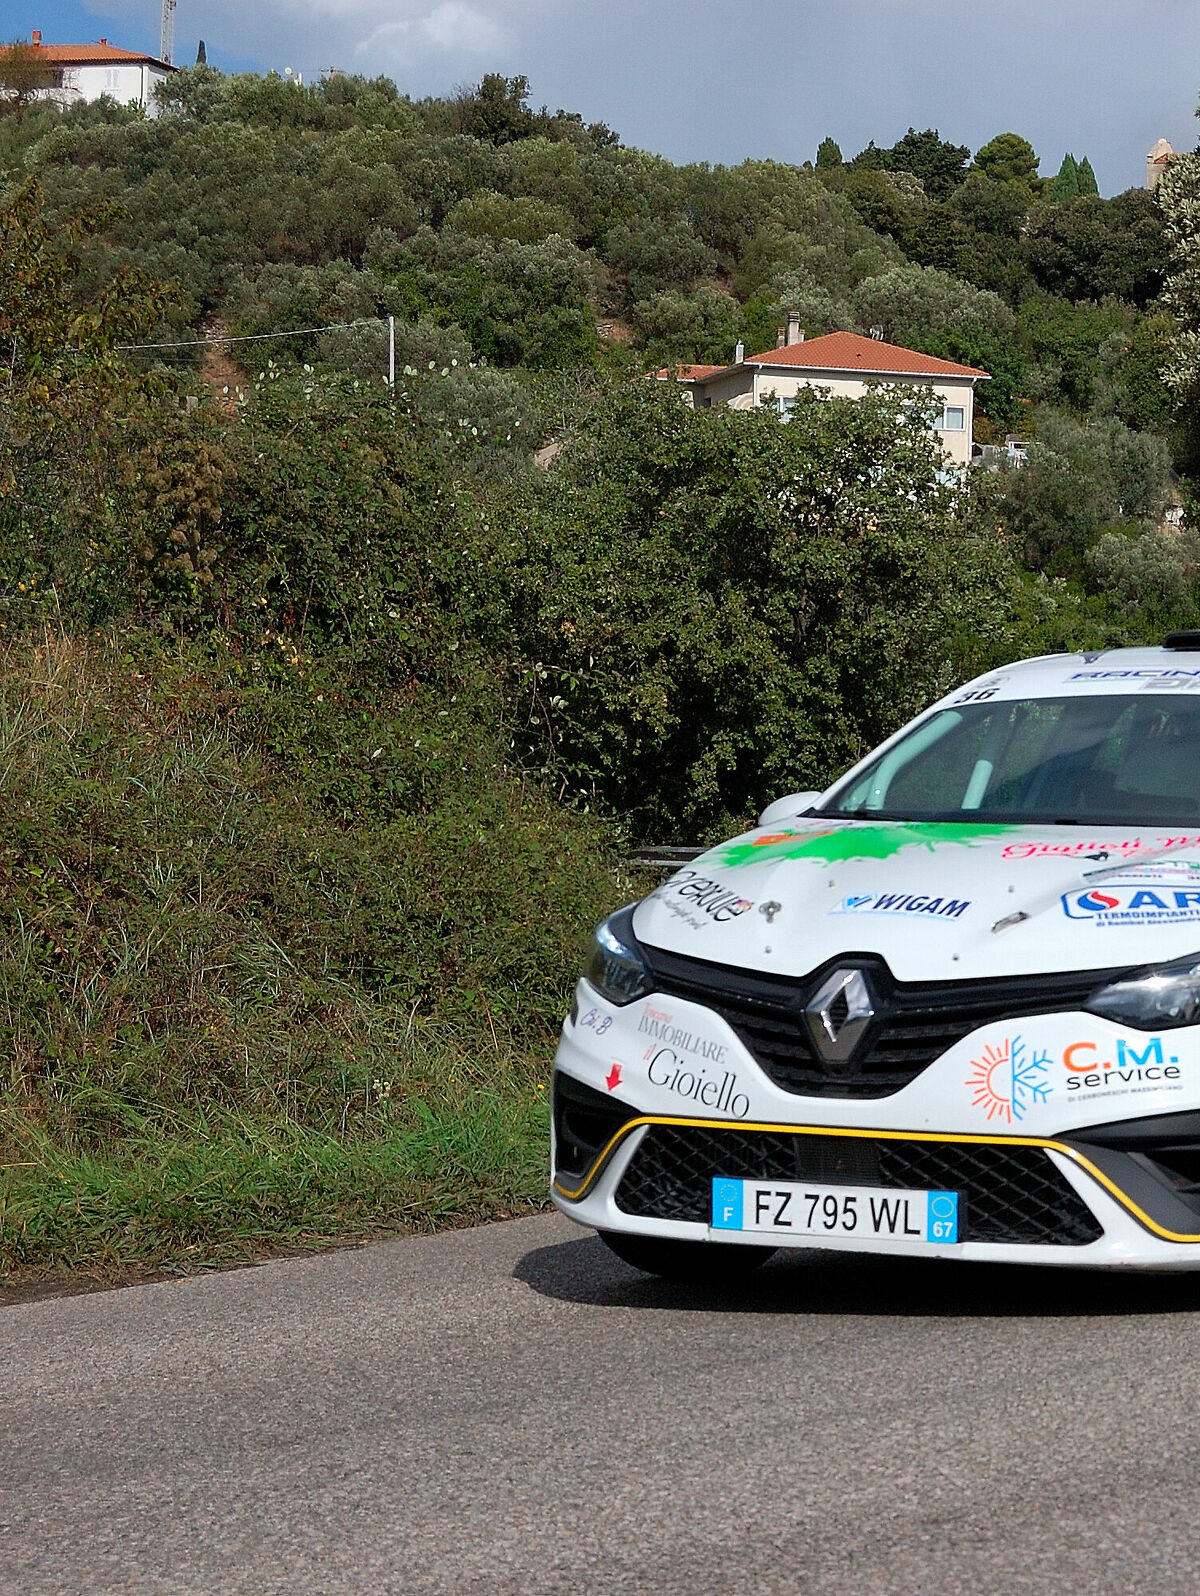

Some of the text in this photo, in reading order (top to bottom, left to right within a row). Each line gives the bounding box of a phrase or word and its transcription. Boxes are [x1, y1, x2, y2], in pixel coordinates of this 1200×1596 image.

[873, 893, 972, 918] WIGAM
[638, 1014, 729, 1065] IMMOBILIARE
[648, 1048, 751, 1119] Gioiello
[1066, 1065, 1181, 1091] service
[723, 1207, 734, 1222] F
[754, 1189, 922, 1235] FZ 795 WL
[932, 1220, 953, 1238] 67
